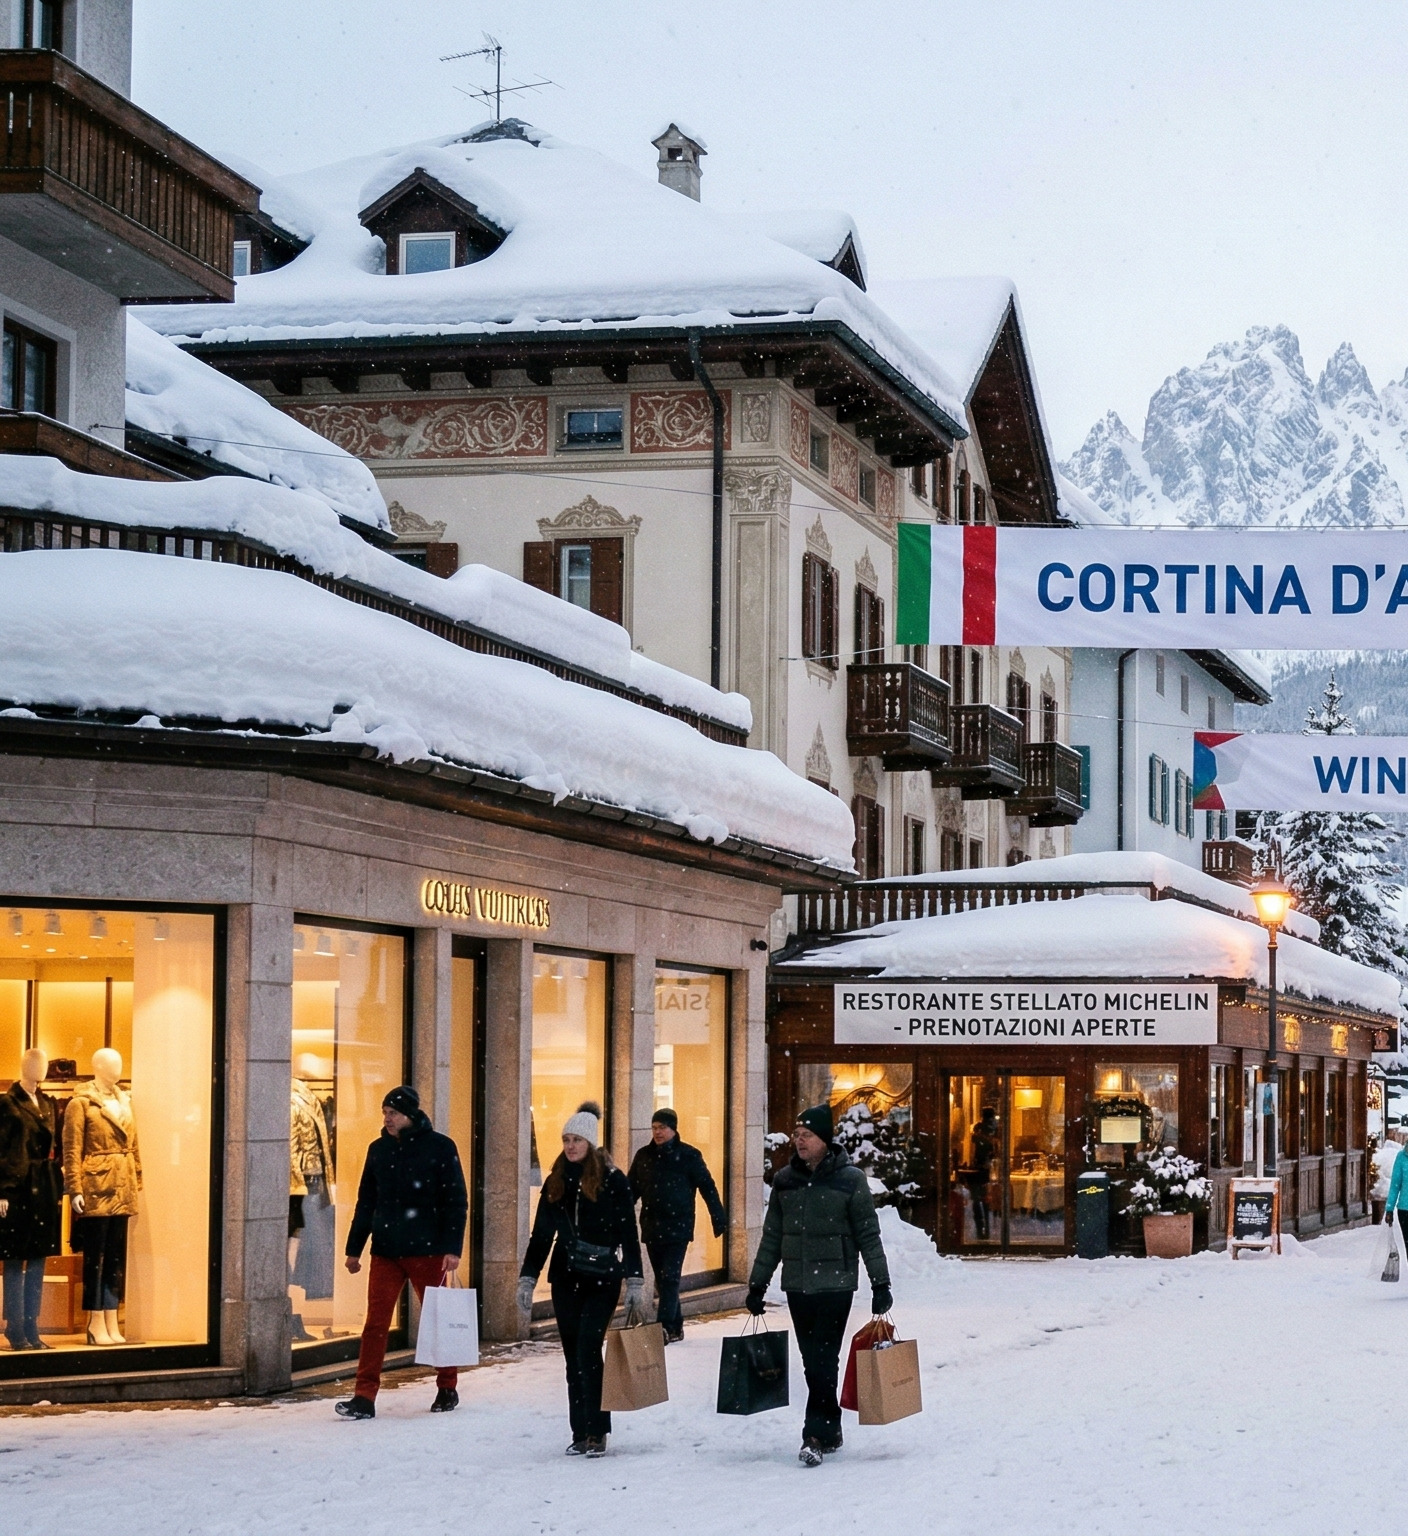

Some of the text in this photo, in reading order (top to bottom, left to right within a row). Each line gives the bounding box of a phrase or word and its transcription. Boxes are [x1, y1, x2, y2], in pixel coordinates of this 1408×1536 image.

[1037, 562, 1312, 615] CORTINA
[843, 992, 1209, 1011] RESTORANTE STELLATO MICHELIN
[909, 1018, 1065, 1037] PRENOTAZIONI
[1071, 1018, 1156, 1037] APERTE
